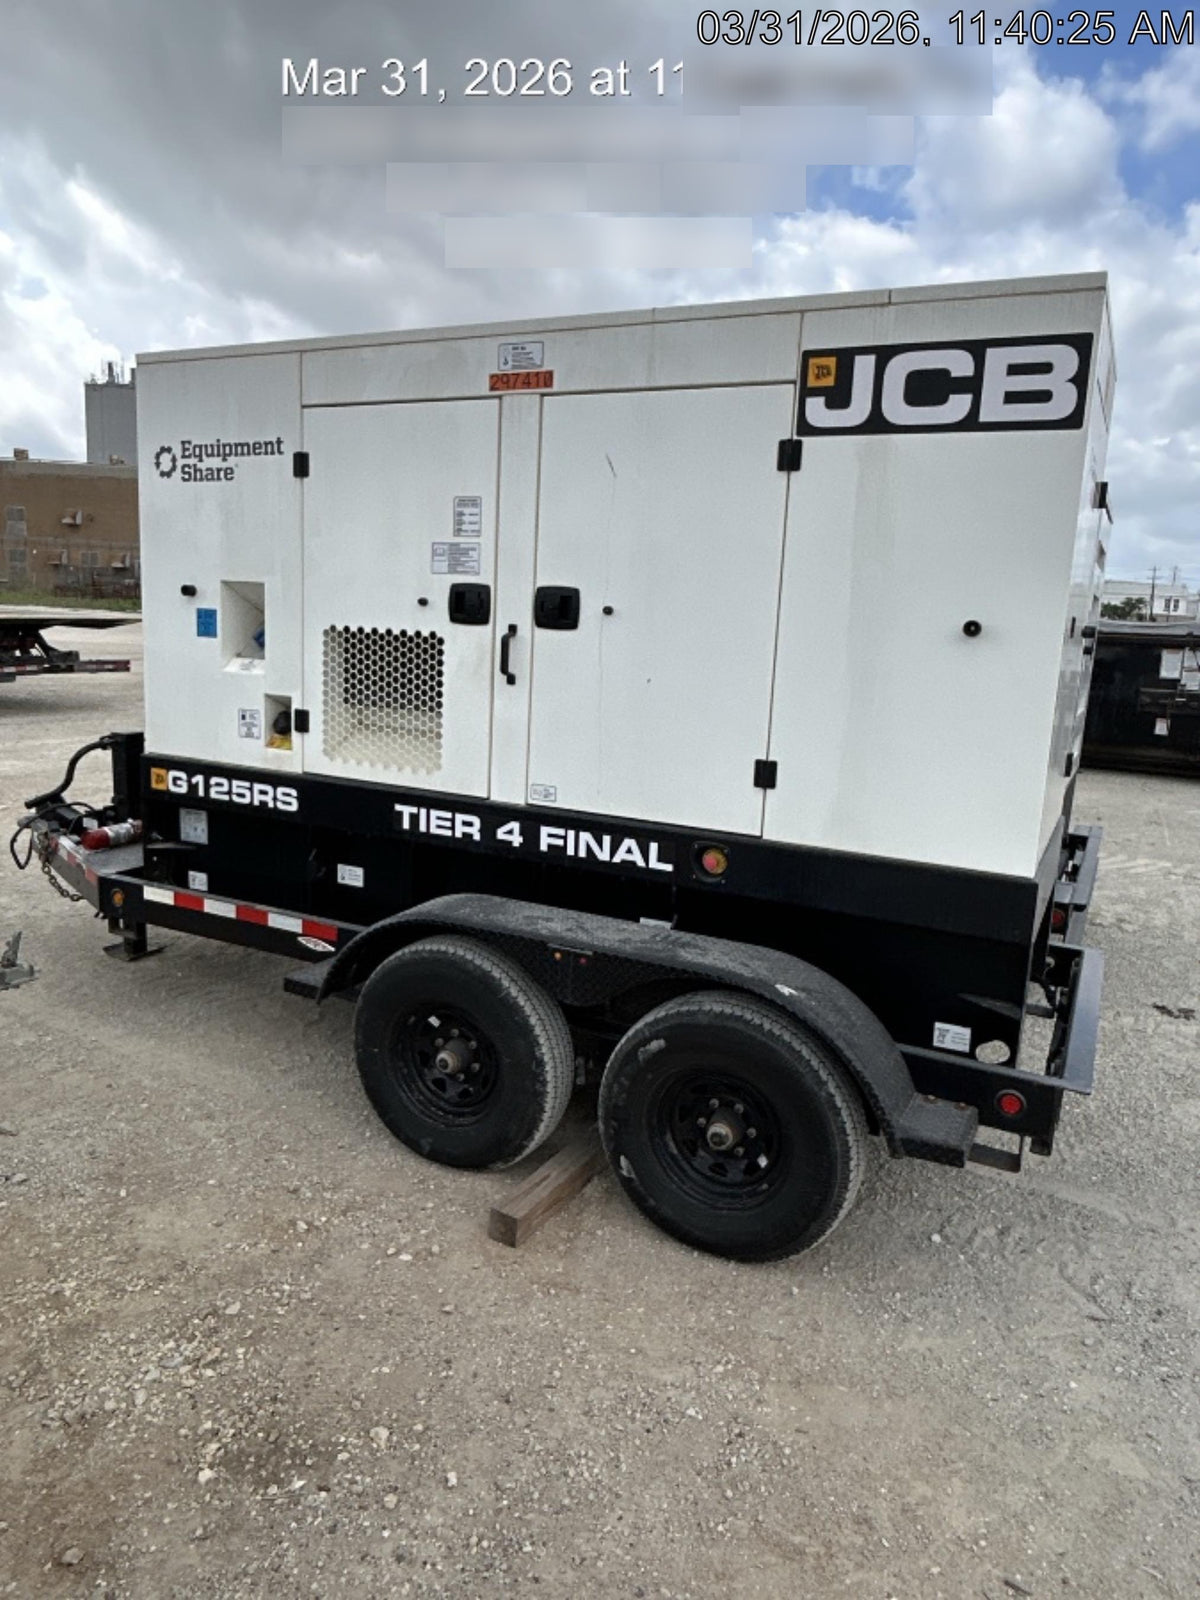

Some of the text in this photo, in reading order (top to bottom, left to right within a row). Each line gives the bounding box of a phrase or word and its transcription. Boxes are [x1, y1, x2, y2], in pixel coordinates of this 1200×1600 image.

[489, 371, 554, 391] 297410
[805, 344, 1080, 428] JCB
[180, 437, 285, 463] Equipment
[180, 463, 235, 483] Share
[167, 769, 299, 812] G125RS
[394, 804, 674, 872] TIER 4 FINAL
